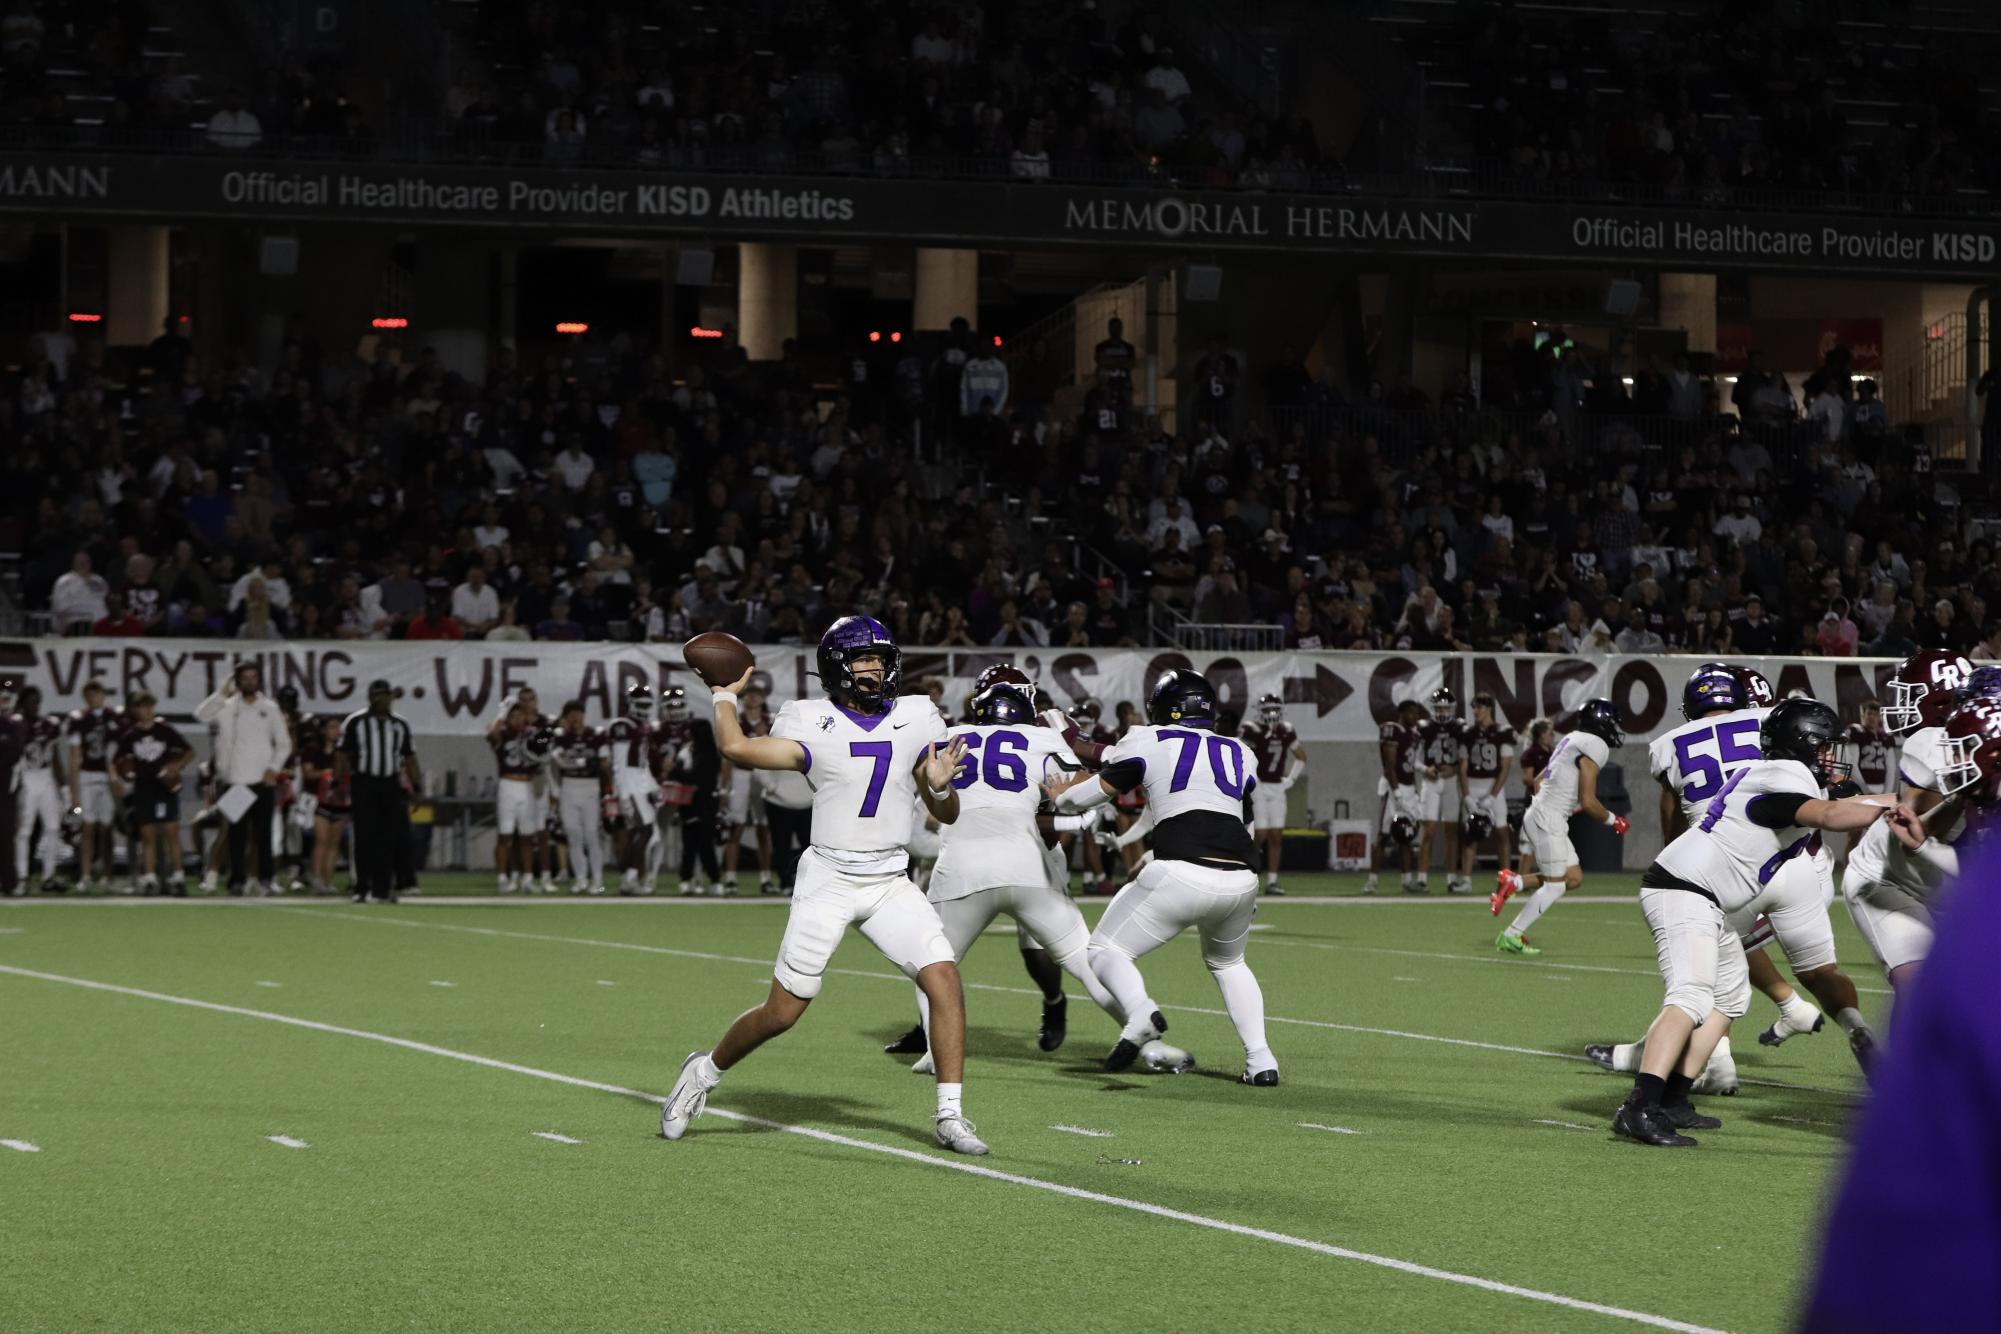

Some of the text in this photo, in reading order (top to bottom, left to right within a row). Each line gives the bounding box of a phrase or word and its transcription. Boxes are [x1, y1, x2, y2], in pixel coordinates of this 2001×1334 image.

[221, 171, 855, 220] Official Healthcare Provider KISD Athletics
[1064, 197, 1473, 242] MEMORIAL HERMANN
[1573, 217, 1996, 263] Official Healthcare Provider KISD
[1369, 656, 1667, 734] CINCO
[850, 740, 893, 817] 7
[951, 730, 1029, 793] 66
[1156, 729, 1244, 801] 70
[1267, 745, 1284, 772] 7
[1673, 718, 1762, 804] 55
